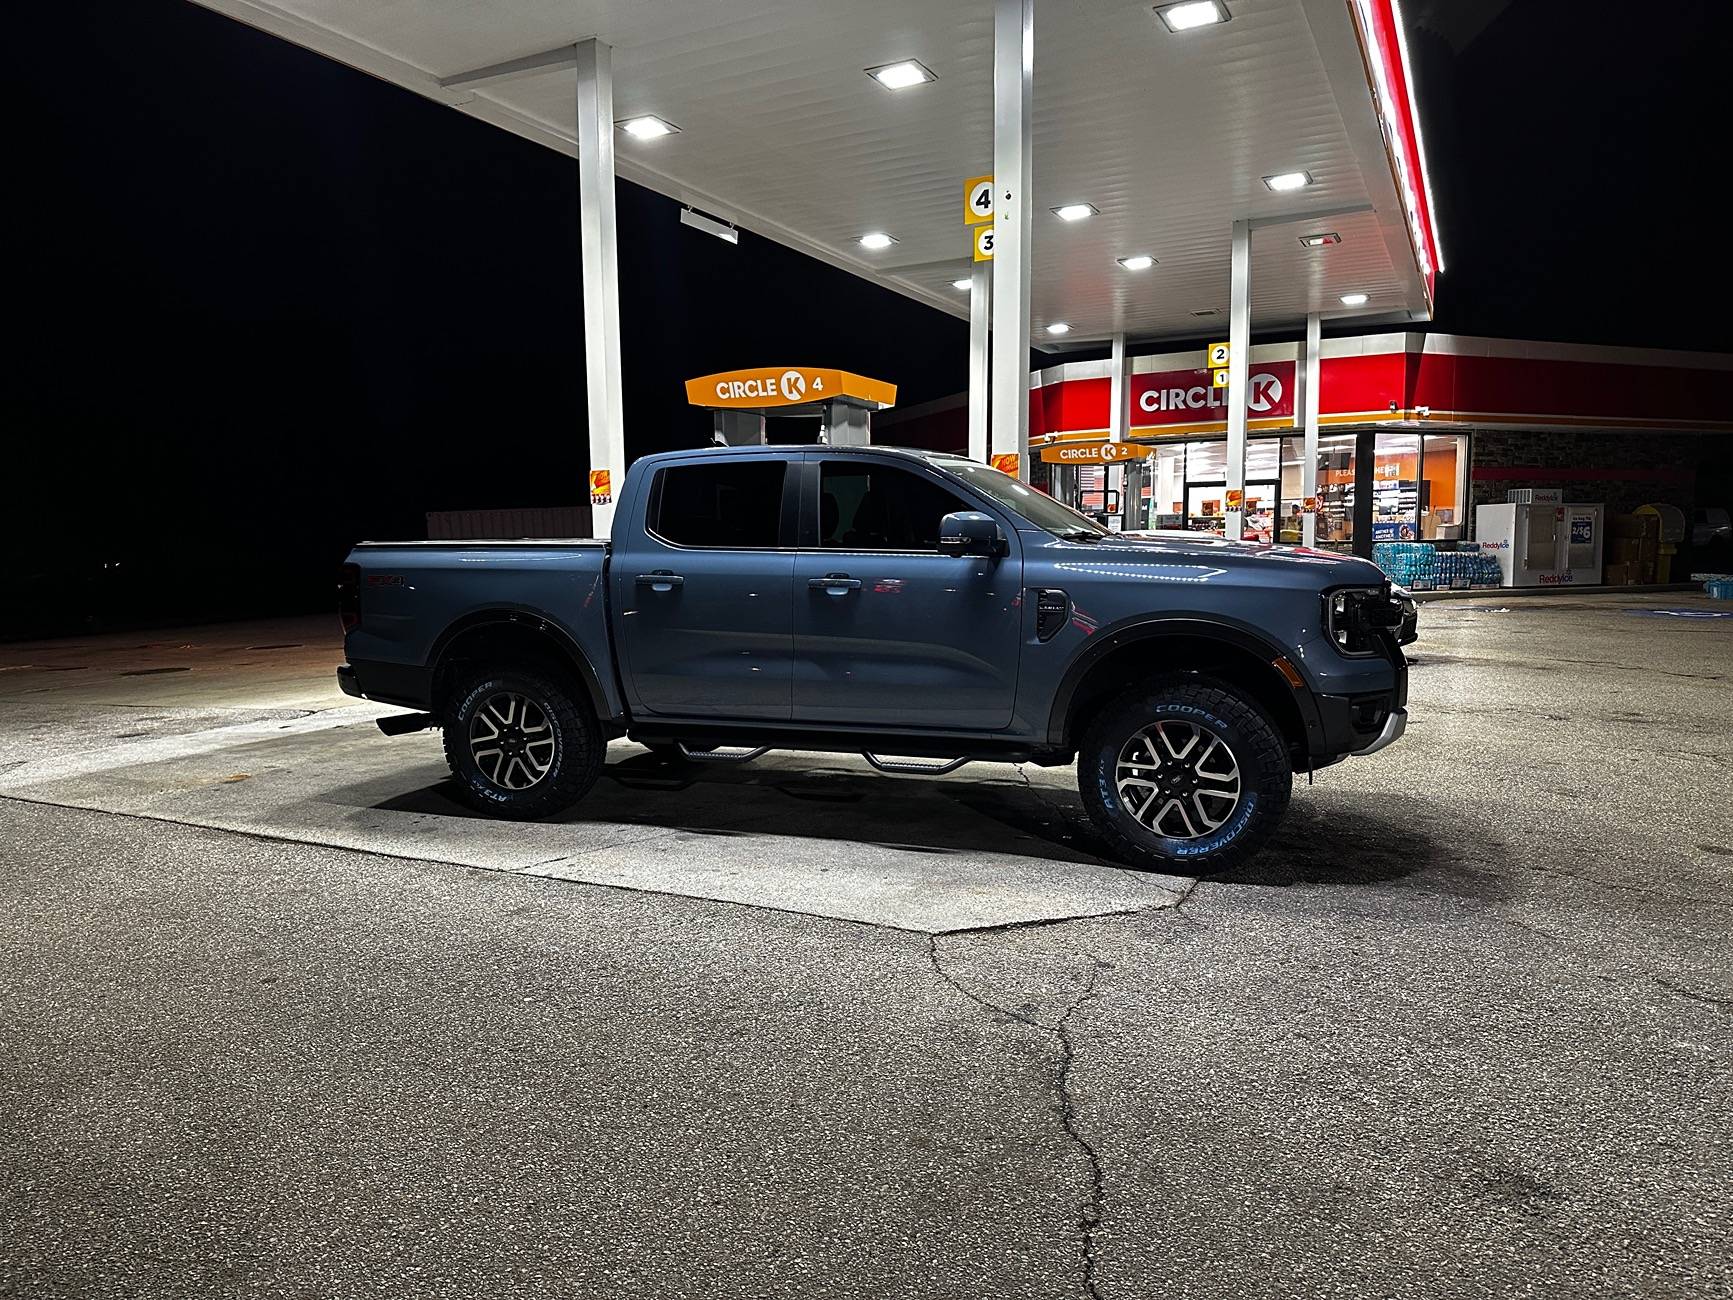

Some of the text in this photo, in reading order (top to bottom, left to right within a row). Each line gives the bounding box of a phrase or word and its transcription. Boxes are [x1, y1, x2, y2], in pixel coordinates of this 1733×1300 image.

[975, 188, 992, 209] 4
[983, 234, 994, 251] 3
[1215, 349, 1226, 360] 2
[716, 377, 777, 400] CIRCLE
[812, 376, 824, 391] 4
[1219, 373, 1226, 383] 1
[1060, 447, 1098, 460] CIRCLE
[1121, 447, 1128, 456] 2
[1335, 469, 1355, 477] PLEAS
[457, 680, 494, 721] COOPER
[1155, 704, 1229, 729] COOPER
[543, 702, 564, 778] DISCOVERER
[1176, 799, 1256, 856] DISCOVERER
